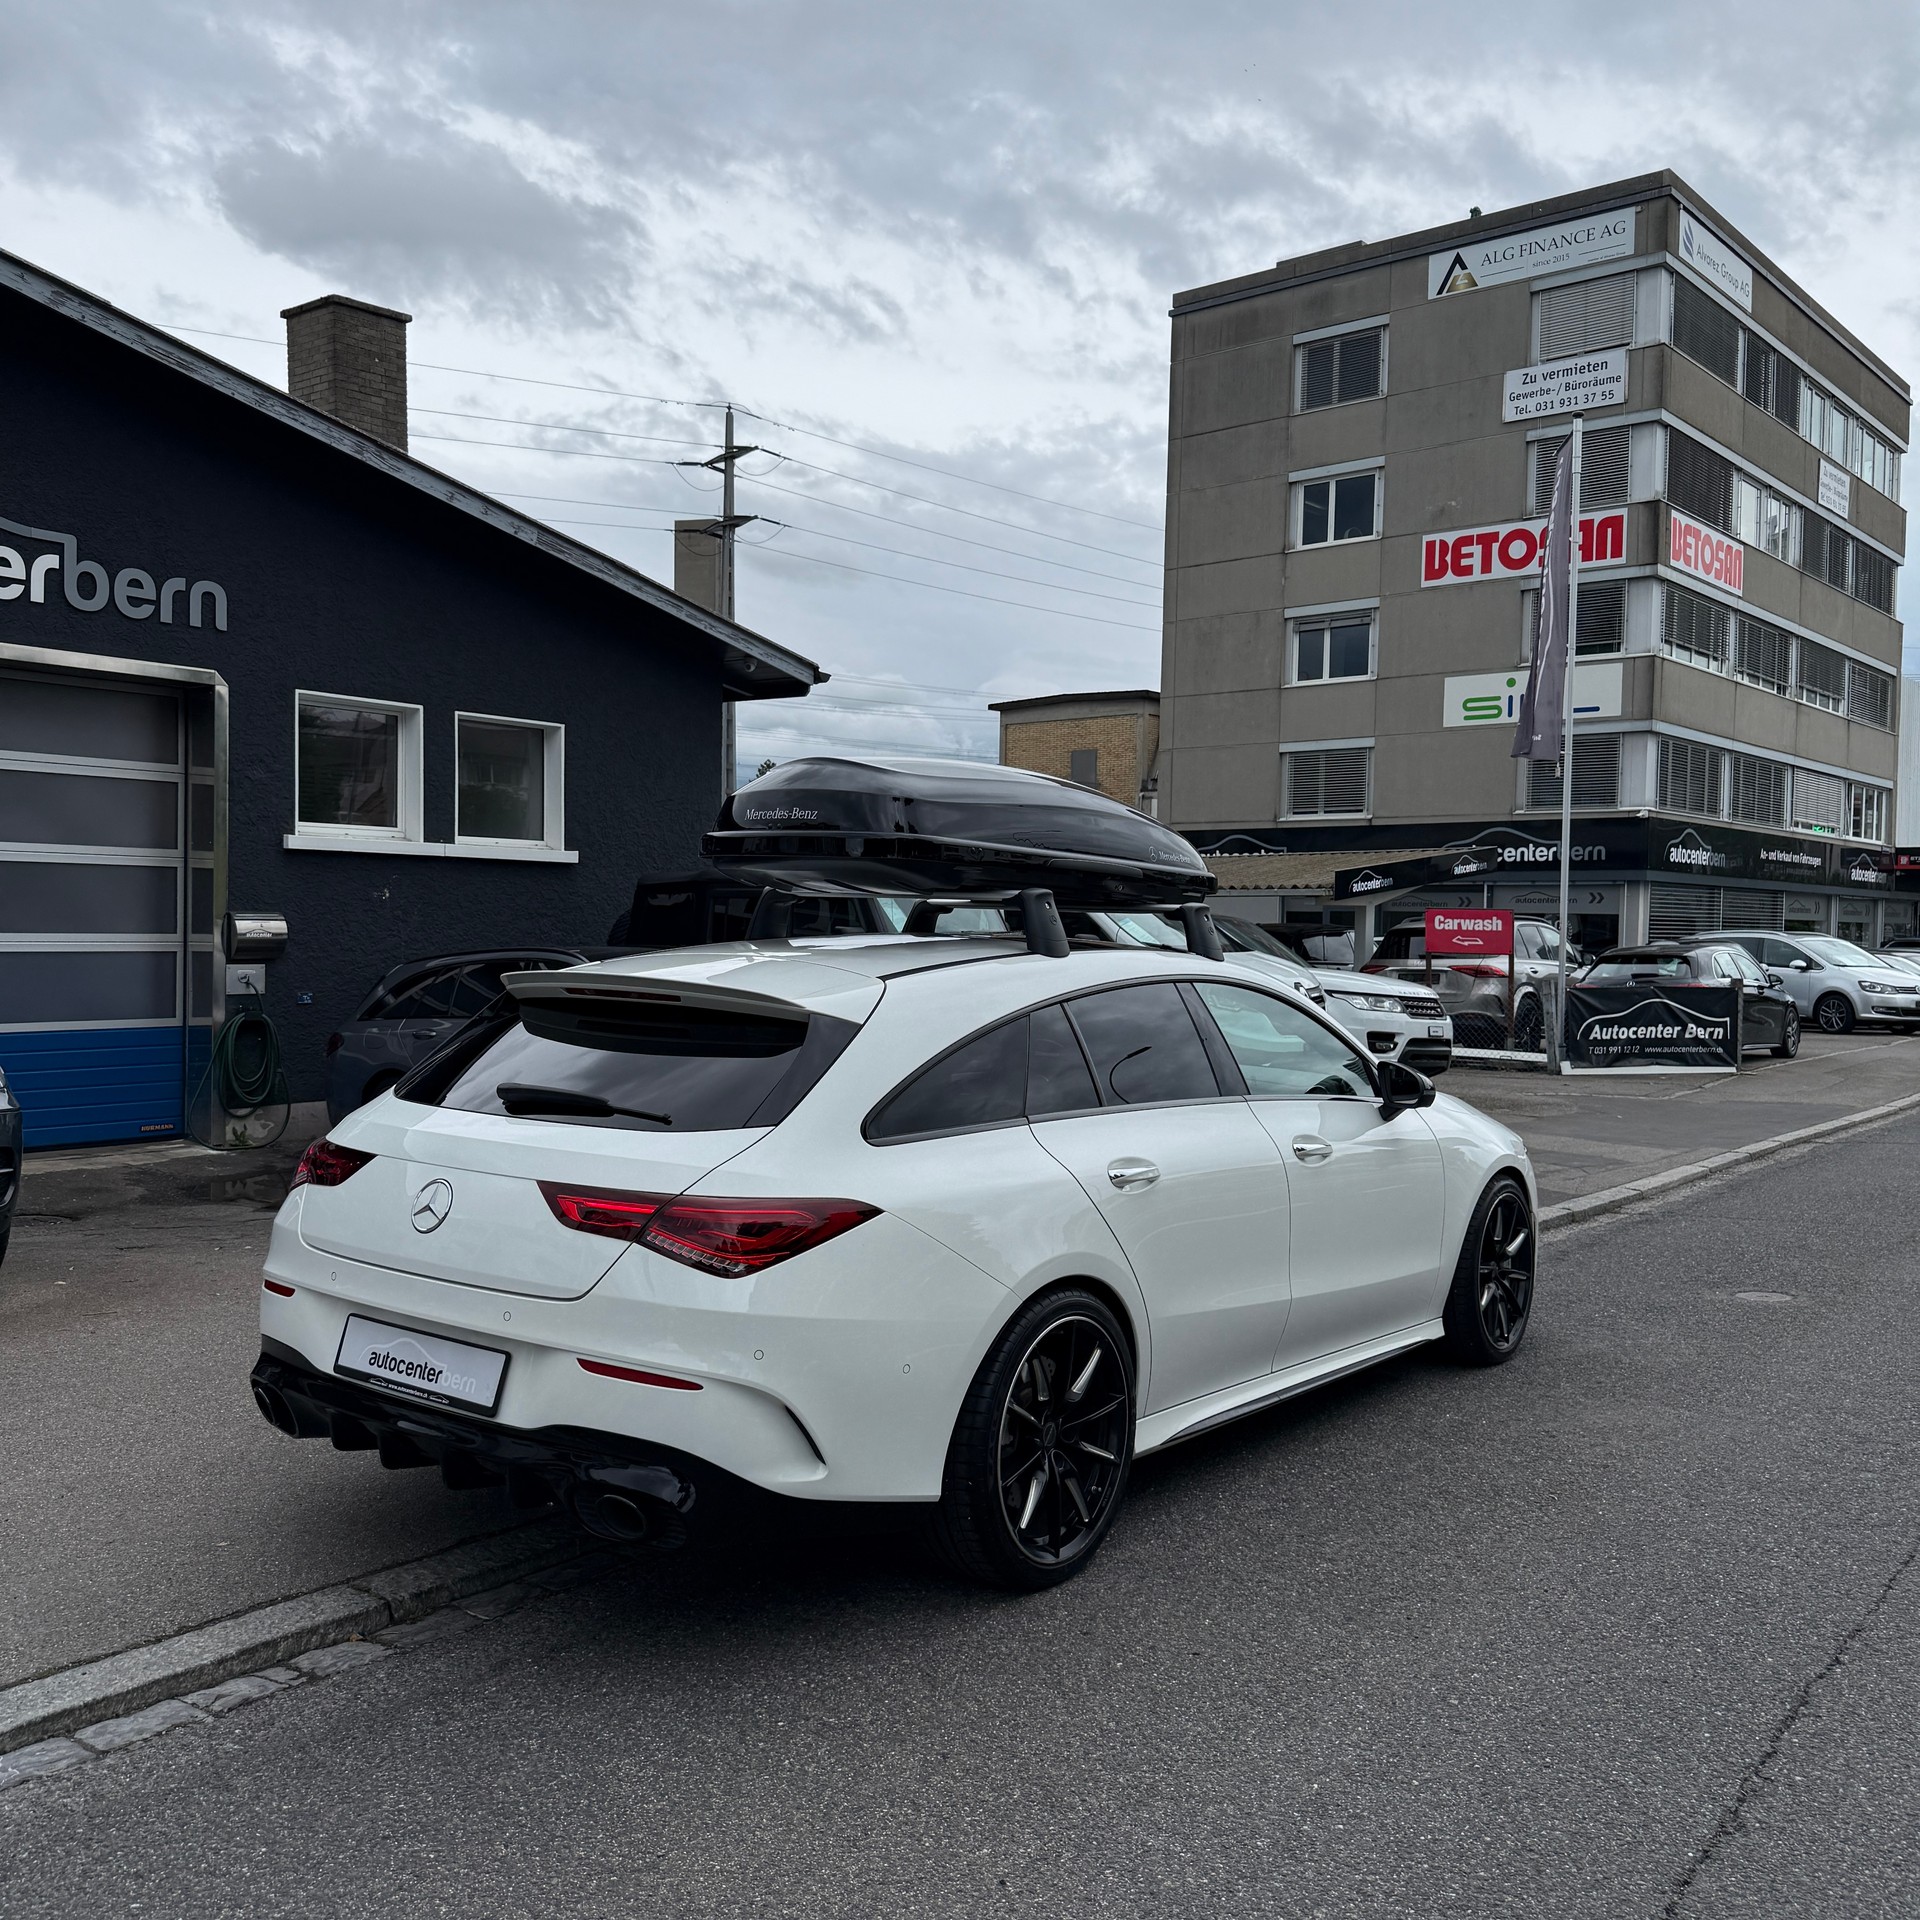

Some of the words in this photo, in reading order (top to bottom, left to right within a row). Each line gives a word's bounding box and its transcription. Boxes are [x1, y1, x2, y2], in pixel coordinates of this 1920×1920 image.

[1480, 246, 1515, 266] ALG
[1519, 227, 1596, 258] FINANCE
[1600, 220, 1626, 238] AG
[1532, 258, 1551, 268] since
[1552, 253, 1570, 264] 2015
[1696, 243, 1720, 273] Alvarez
[1721, 263, 1739, 292] Group
[1740, 280, 1750, 298] AG
[1522, 373, 1537, 385] Zu
[1542, 360, 1608, 381] vermieten
[1564, 375, 1622, 392] Büroräume
[1514, 405, 1532, 415] Tel.
[1535, 400, 1554, 412] 031
[1560, 396, 1578, 408] 931
[1583, 393, 1596, 404] 37
[1600, 390, 1614, 400] 55
[1672, 516, 1742, 590] BETOSAN
[744, 808, 818, 820] Mercedes-Benz
[1670, 844, 1726, 868] autocenterbern
[1352, 877, 1394, 892] autocenterbern
[1434, 915, 1502, 931] Carwash
[1589, 1024, 1682, 1040] Autocenter
[1684, 1023, 1724, 1040] Bern
[1588, 1046, 1594, 1054] T
[1594, 1046, 1607, 1054] 031
[1608, 1046, 1622, 1054] 991
[368, 1351, 476, 1394] autocenterbern
